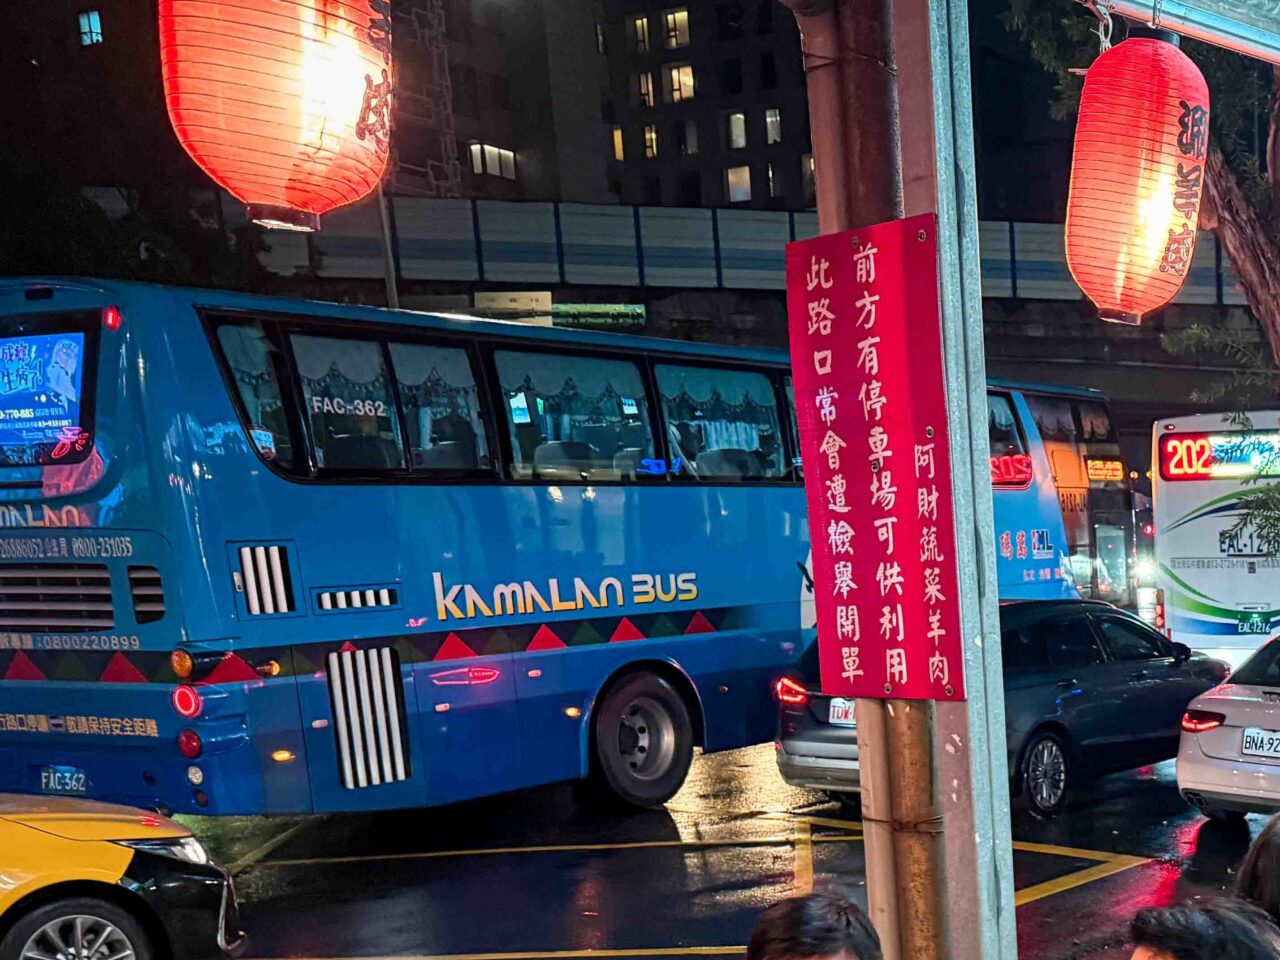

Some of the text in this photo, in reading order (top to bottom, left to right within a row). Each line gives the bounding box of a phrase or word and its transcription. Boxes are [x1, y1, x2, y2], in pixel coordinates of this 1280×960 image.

[312, 396, 386, 417] FAC-362
[806, 255, 864, 684] 此路口常會遭檢舉開單
[853, 242, 908, 686] 前方有停車場可供利用
[1167, 439, 1212, 475] 202
[914, 443, 949, 686] 阿財蔬菜羊肉
[432, 572, 698, 621] KAMALAN BUS
[41, 772, 86, 791] FAC-362
